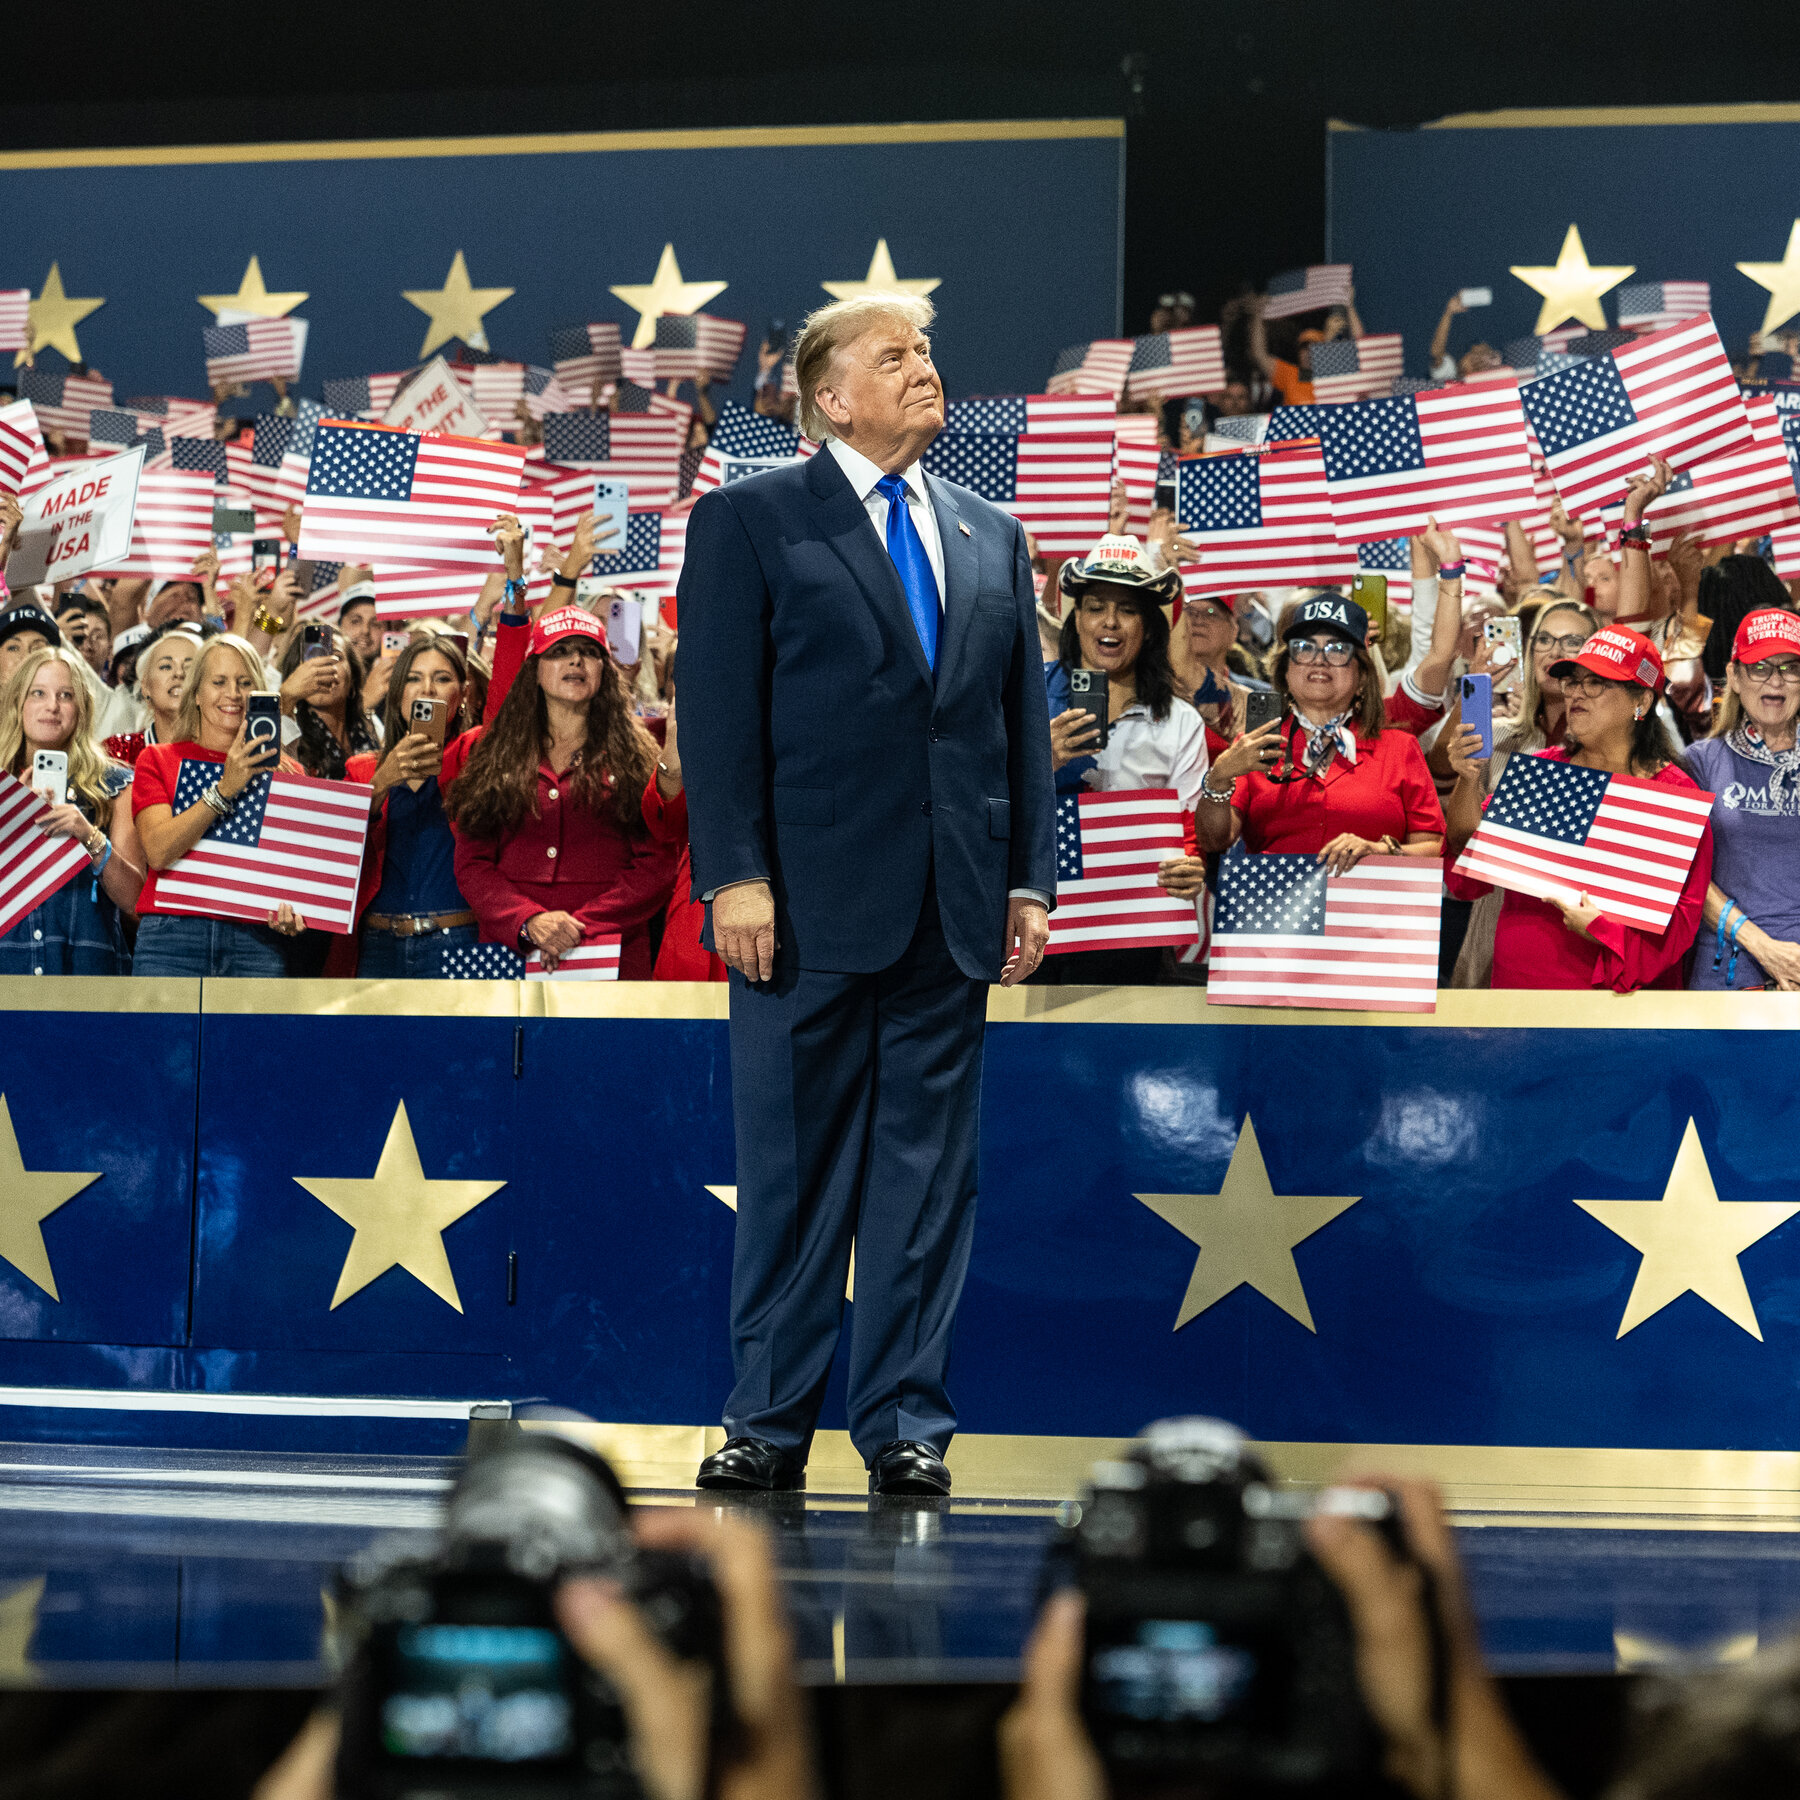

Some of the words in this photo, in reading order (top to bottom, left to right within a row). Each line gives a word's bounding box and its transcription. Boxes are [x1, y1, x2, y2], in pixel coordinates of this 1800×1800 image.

[416, 384, 448, 418] THE
[41, 475, 112, 520] MADE
[51, 520, 64, 537] IN
[69, 510, 93, 530] THE
[45, 532, 90, 566] USA
[1099, 548, 1138, 560] TRUMP
[540, 612, 564, 628] MAKE
[564, 609, 602, 628] AMERICA
[1304, 601, 1349, 625] USA
[1752, 613, 1785, 625] TRUMP
[544, 619, 573, 636] GREAT
[574, 620, 599, 636] AGAIN
[1747, 622, 1777, 635] RIGHT
[1593, 643, 1626, 664] AGAIN
